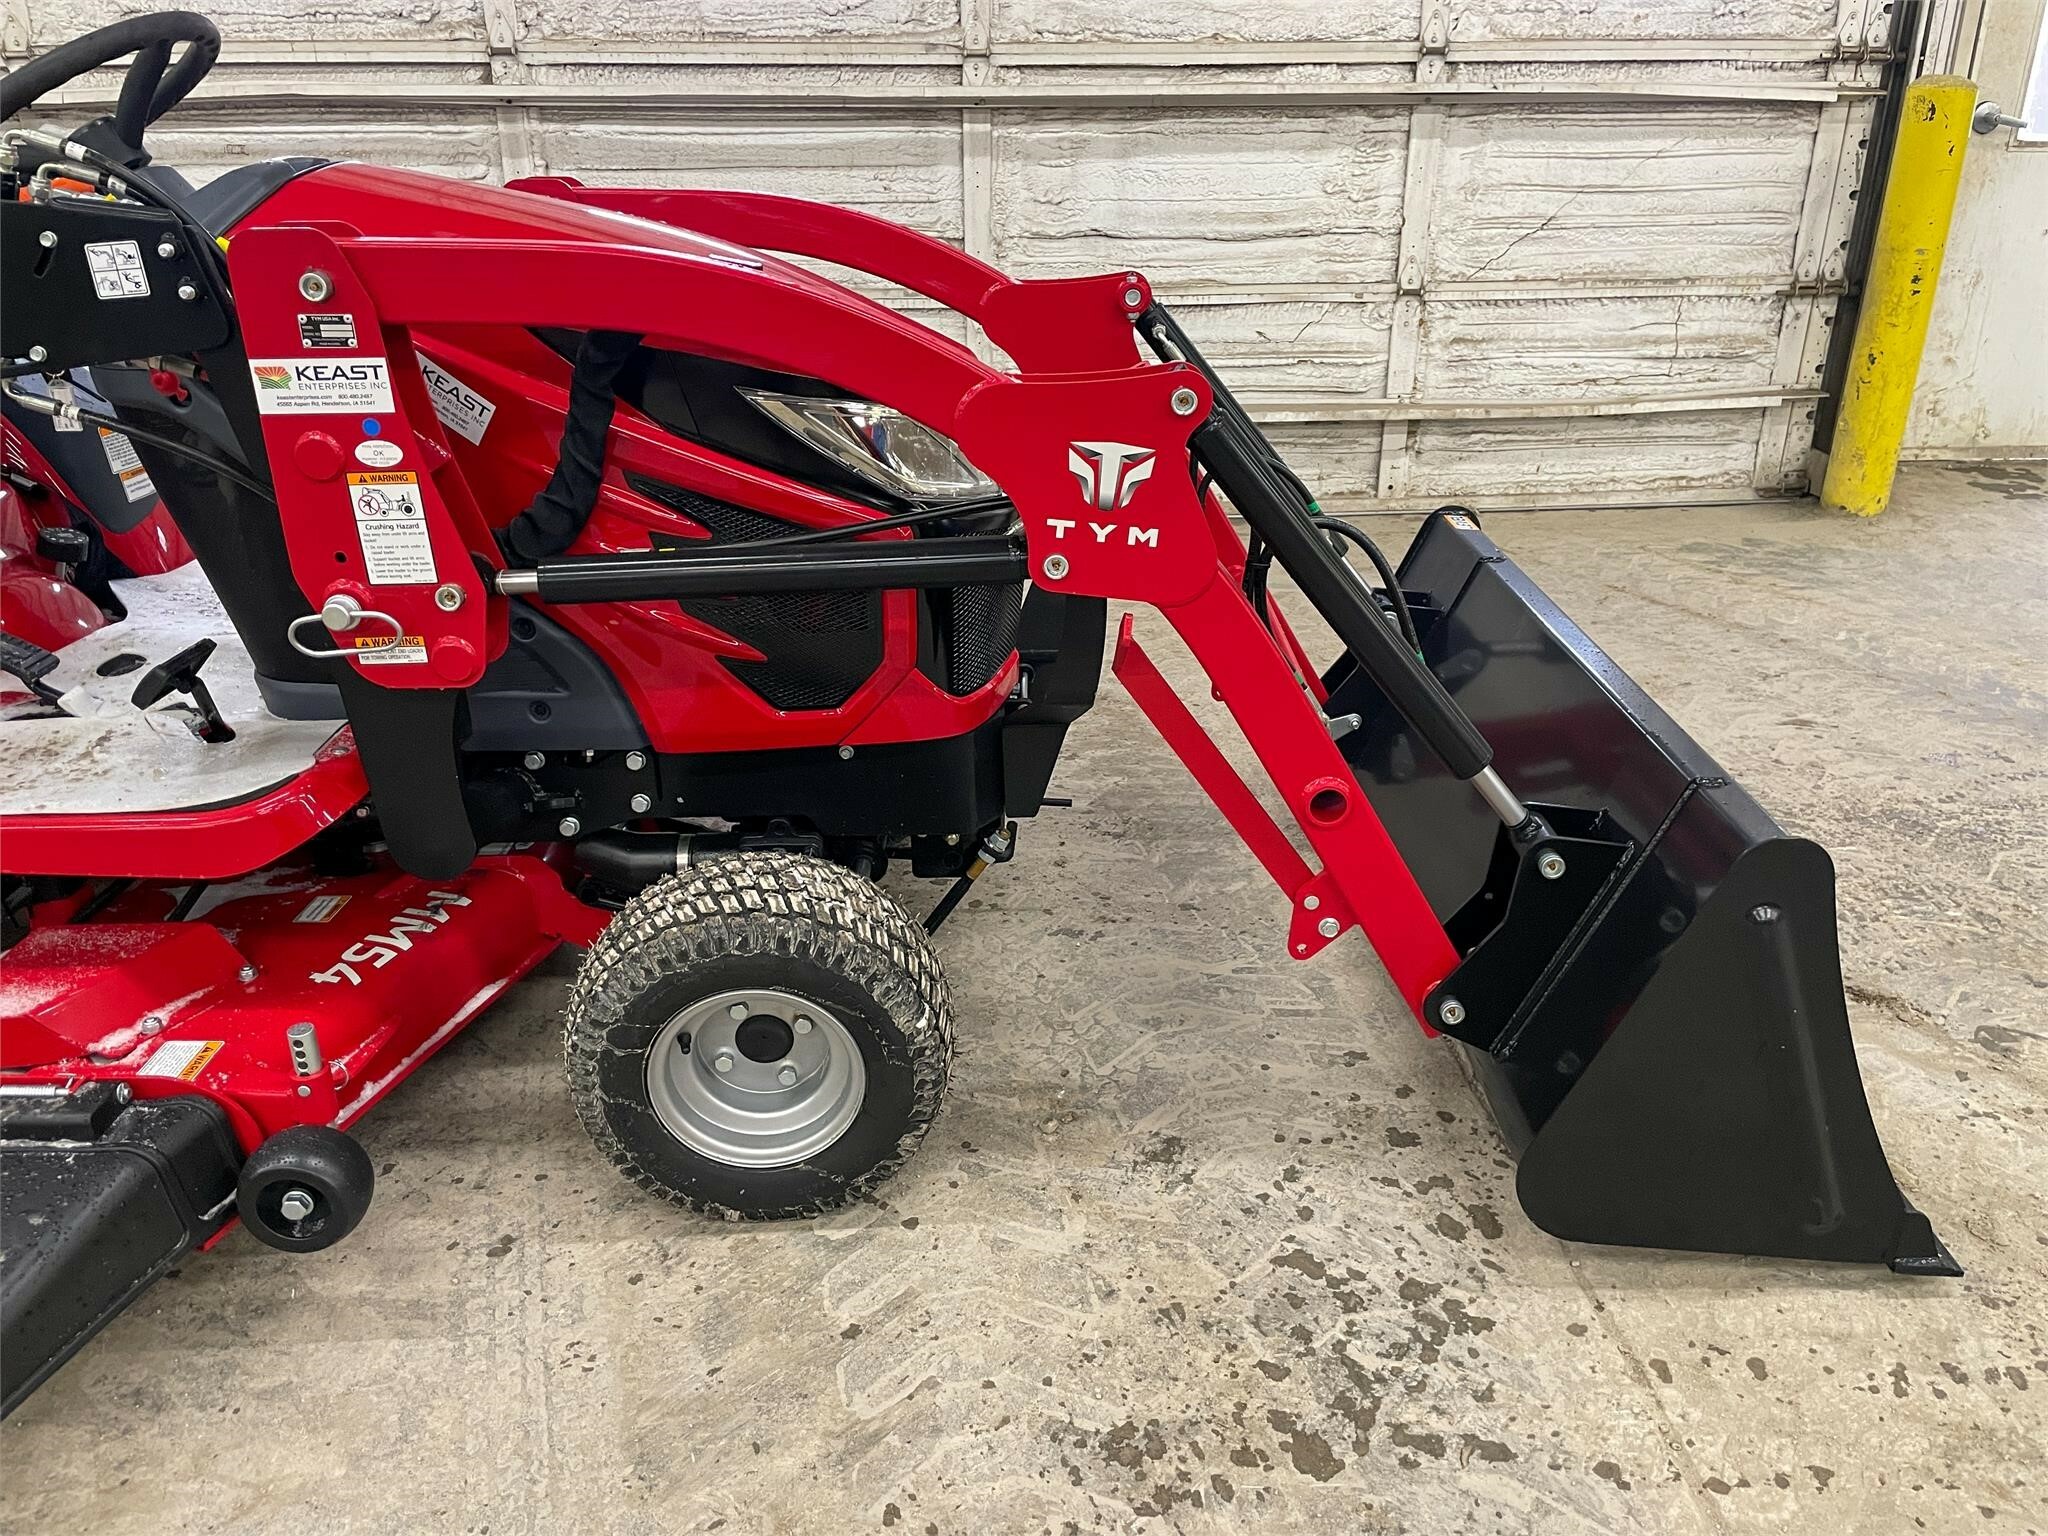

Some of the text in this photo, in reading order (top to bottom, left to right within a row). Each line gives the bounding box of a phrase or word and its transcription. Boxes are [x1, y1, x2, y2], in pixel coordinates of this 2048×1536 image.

[295, 365, 383, 381] KEAST
[298, 382, 388, 391] ENTERPRISES INC
[422, 365, 491, 417] KEAST
[427, 384, 469, 417] TERPRISES
[471, 415, 486, 428] INC
[369, 473, 409, 482] WARNING
[365, 523, 394, 531] Crushing
[1046, 518, 1159, 548] TYM
[308, 890, 472, 986] MM54
